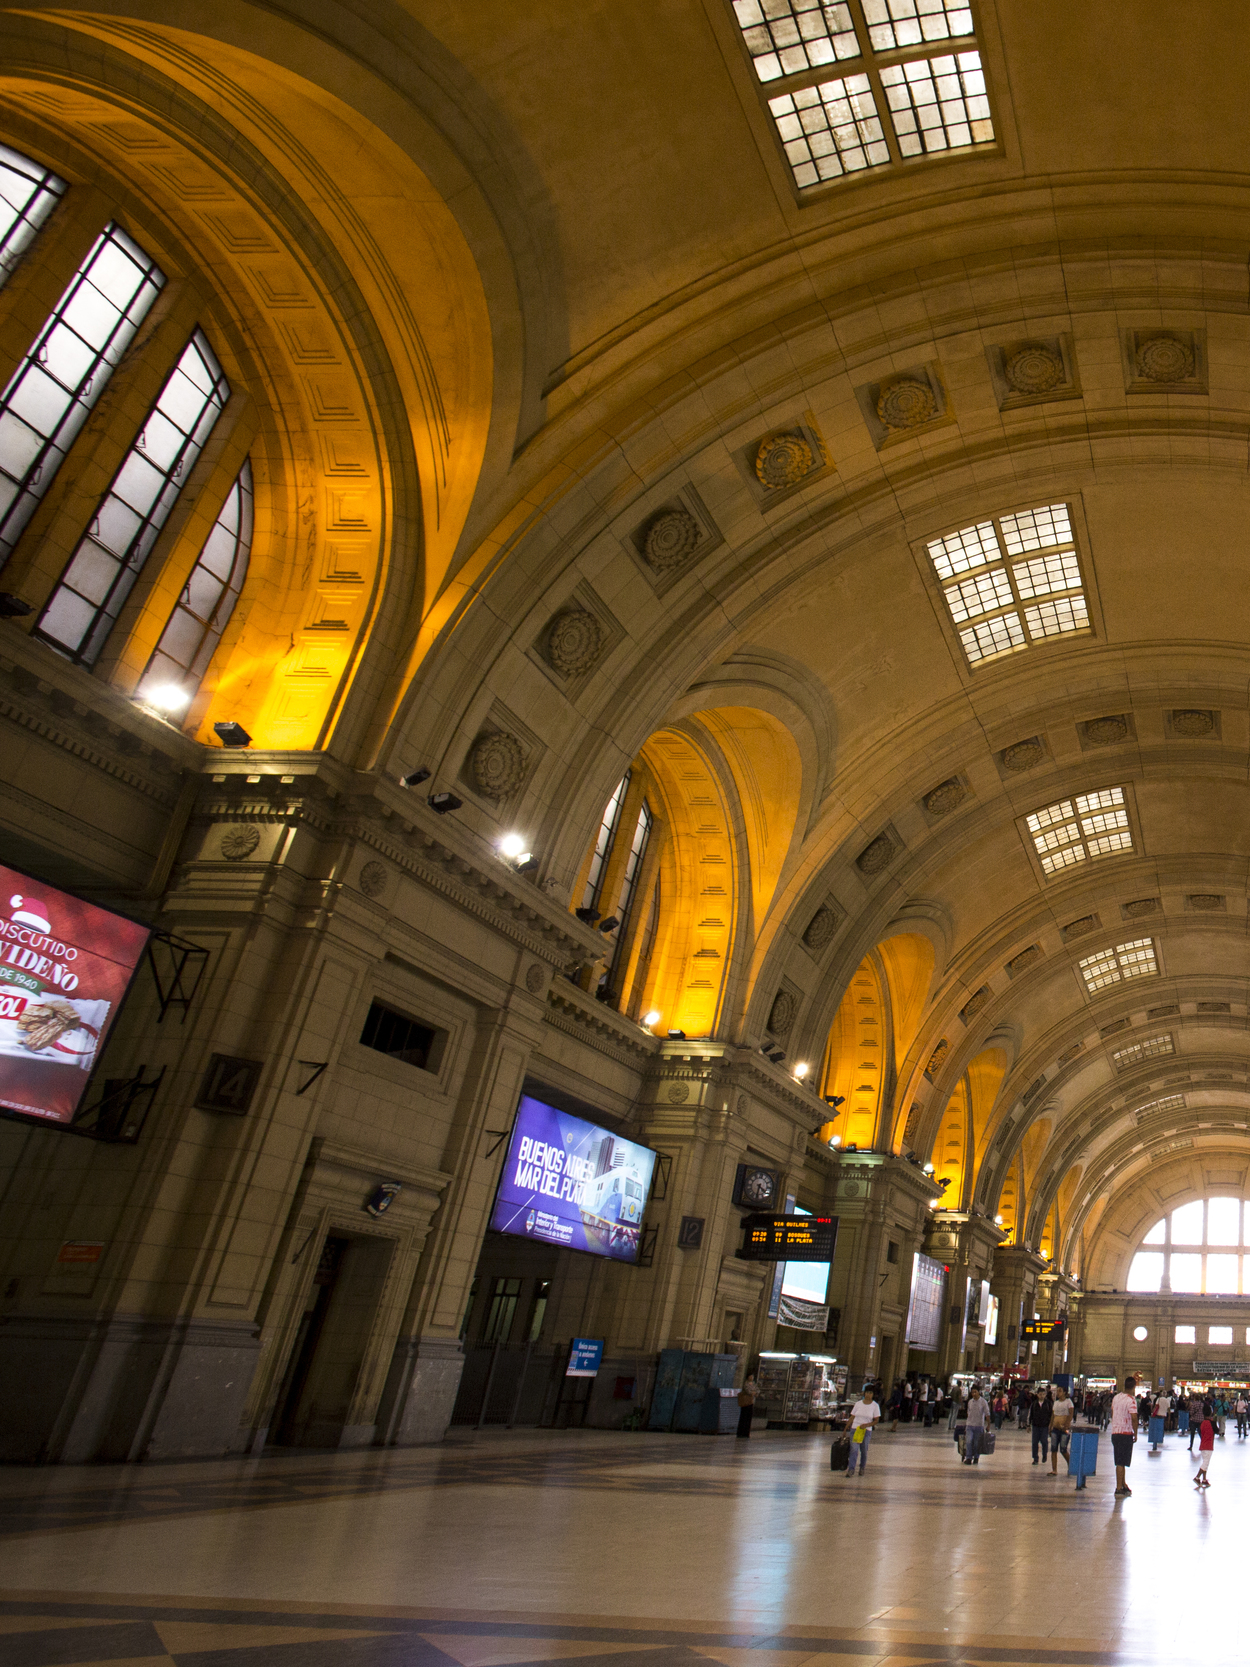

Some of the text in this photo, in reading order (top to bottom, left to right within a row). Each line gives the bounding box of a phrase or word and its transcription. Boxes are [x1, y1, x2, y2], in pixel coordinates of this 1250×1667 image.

[15, 973, 38, 990] 1940
[0, 996, 21, 1018] OL
[207, 1062, 250, 1104] 14
[518, 1136, 596, 1182] BUENOS AIRES
[514, 1160, 590, 1206] MAR DEL PLATA
[682, 1221, 700, 1244] 12
